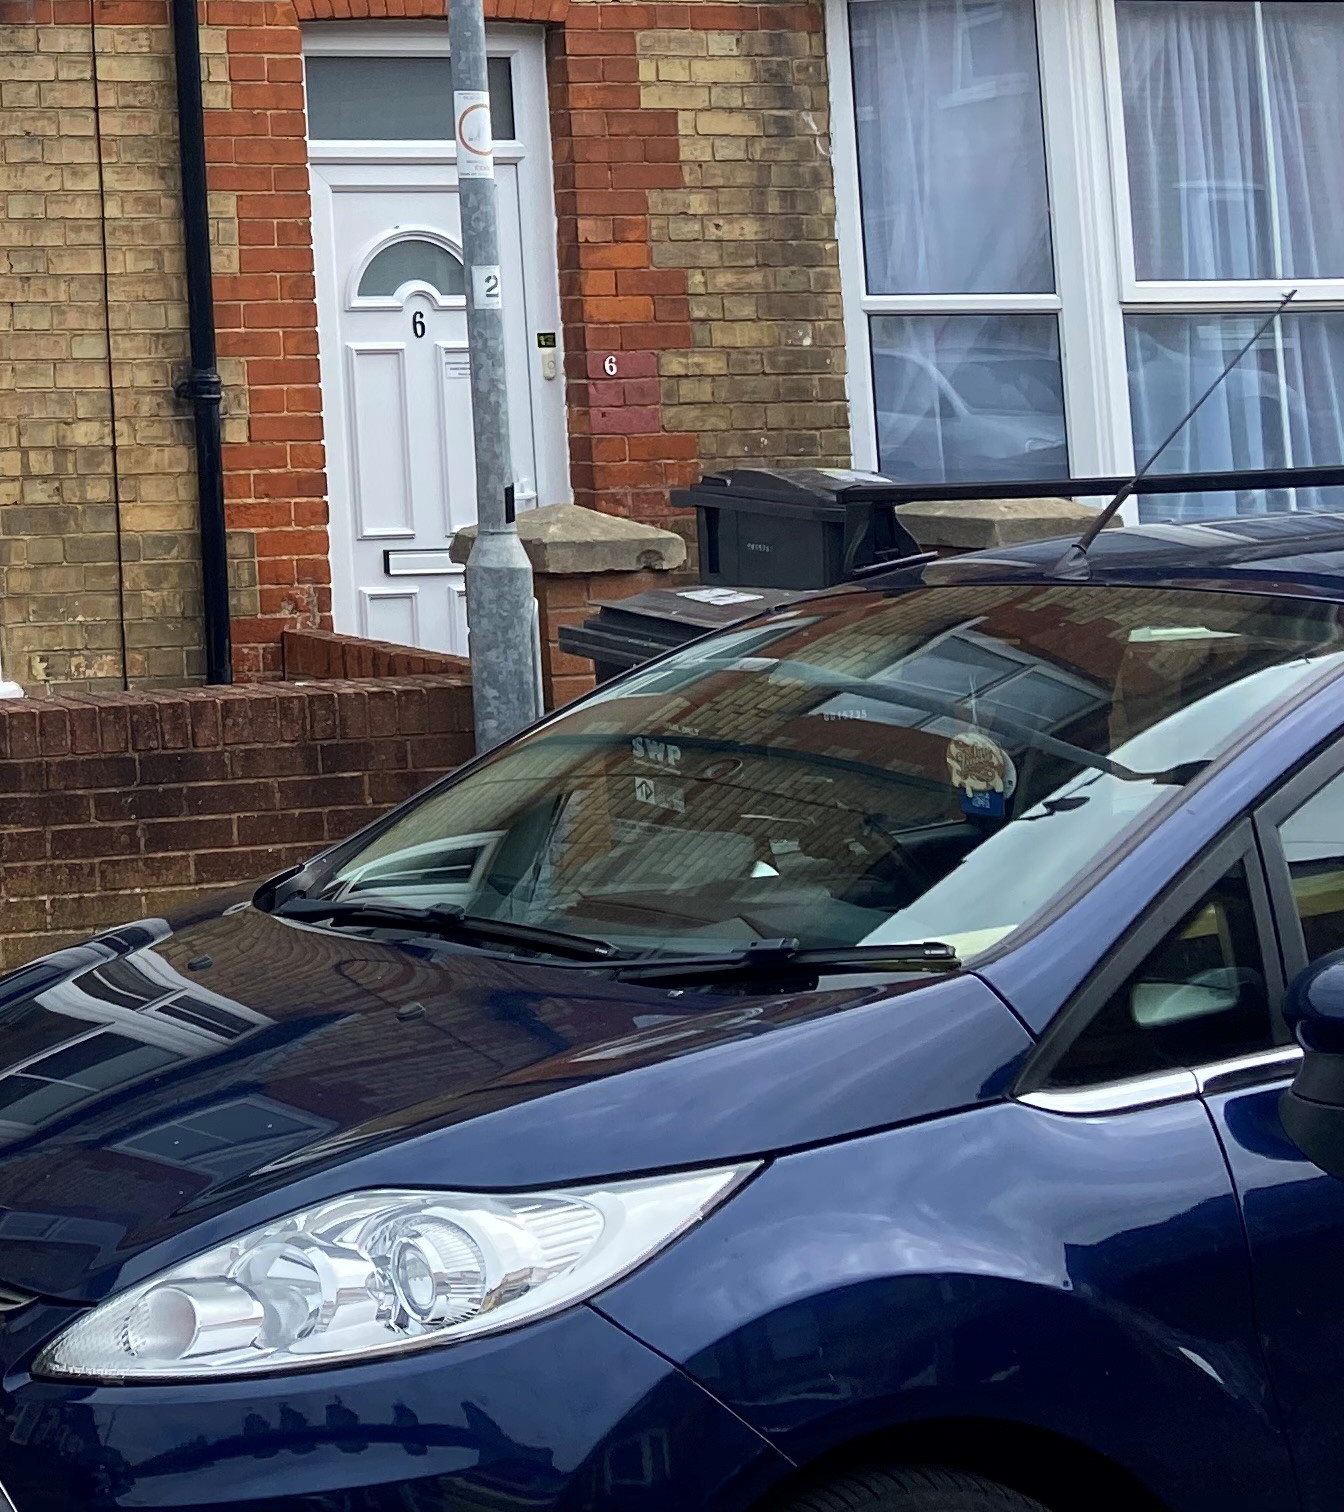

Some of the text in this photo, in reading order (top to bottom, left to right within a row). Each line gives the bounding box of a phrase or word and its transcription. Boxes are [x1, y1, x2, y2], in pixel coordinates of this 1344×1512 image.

[484, 274, 500, 298] 2
[412, 311, 426, 338] 6
[604, 355, 618, 376] 6
